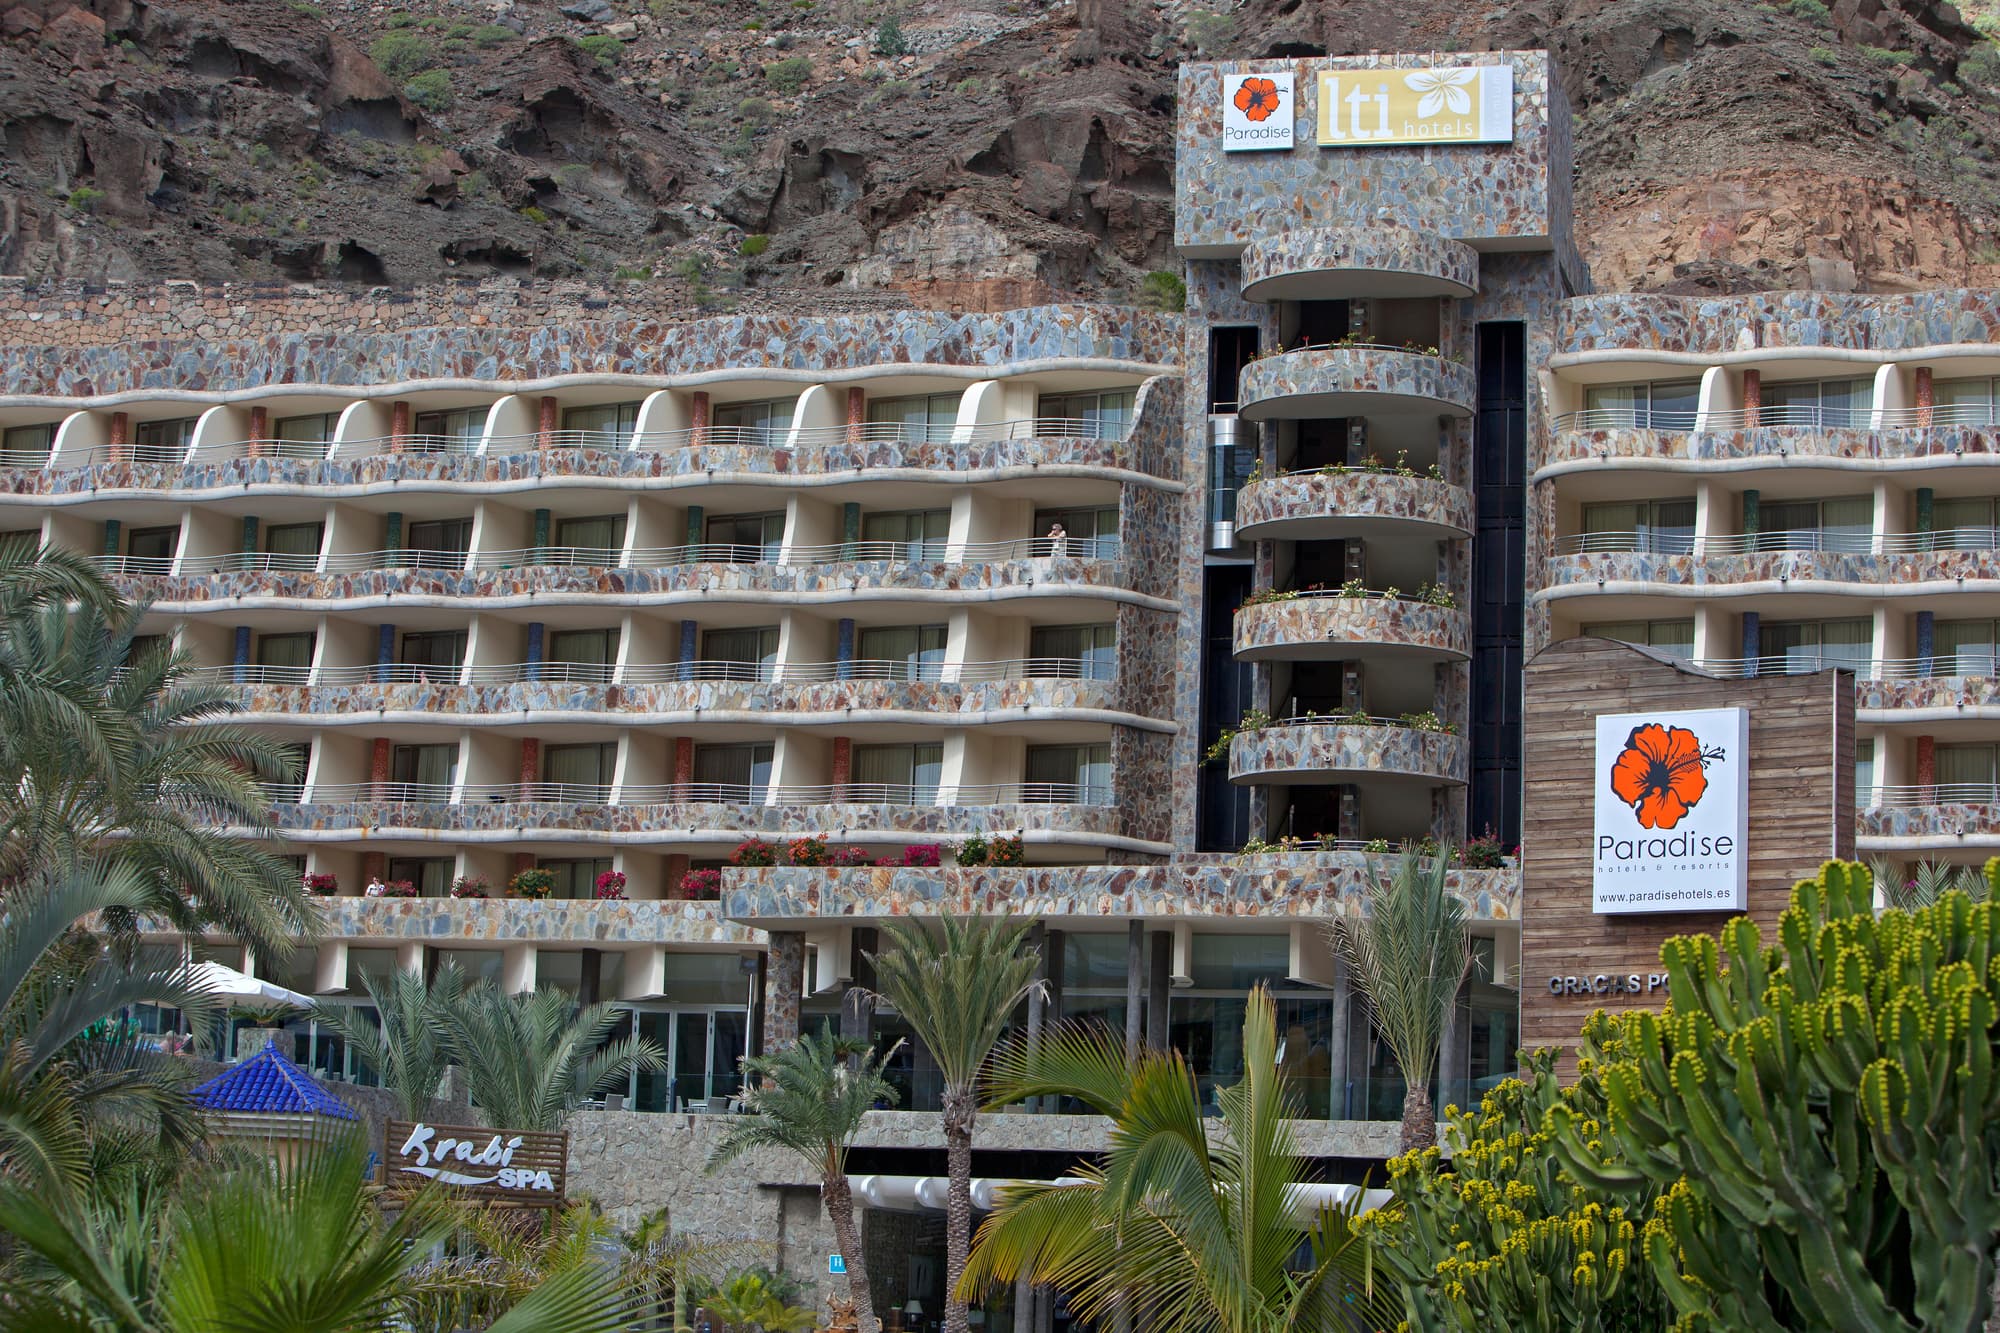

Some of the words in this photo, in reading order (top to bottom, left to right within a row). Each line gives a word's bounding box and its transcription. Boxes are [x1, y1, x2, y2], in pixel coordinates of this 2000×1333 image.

[1325, 77, 1393, 139] lti
[1225, 125, 1290, 141] Paradise
[1404, 118, 1473, 137] hotels
[1599, 831, 1733, 860] Paradise
[1599, 864, 1646, 873] hotels
[1674, 862, 1729, 871] resorts
[1599, 888, 1731, 904] www.paradisehotels.es
[1549, 974, 1641, 995] GRACIAS
[400, 1123, 523, 1167] Krabi
[497, 1168, 554, 1192] SPA
